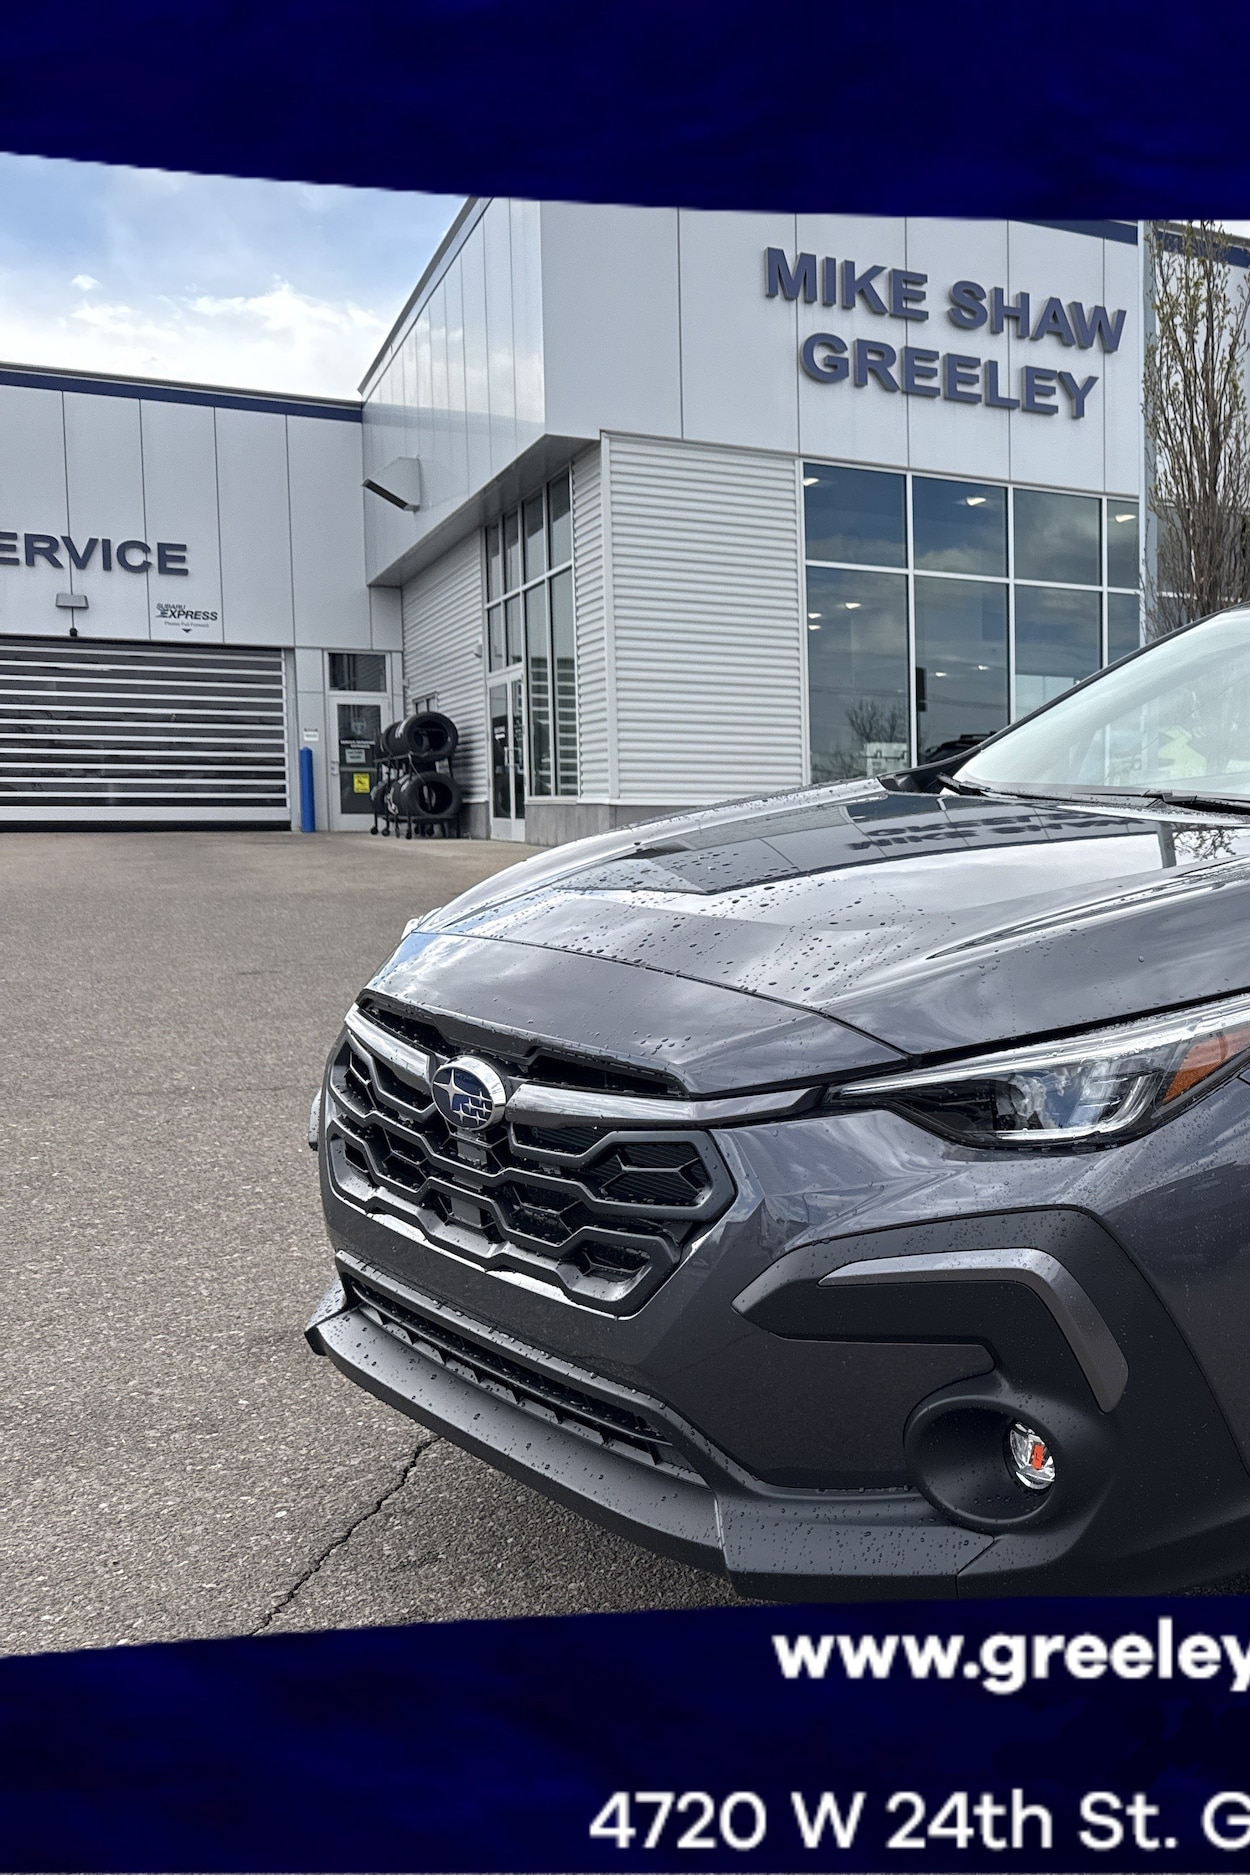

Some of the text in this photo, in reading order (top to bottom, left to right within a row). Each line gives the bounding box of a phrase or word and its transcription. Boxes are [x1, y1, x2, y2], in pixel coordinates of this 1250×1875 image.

[764, 246, 1127, 353] MIKE SHAW
[800, 332, 1099, 420] GREELEY
[158, 609, 218, 621] EXPRESS
